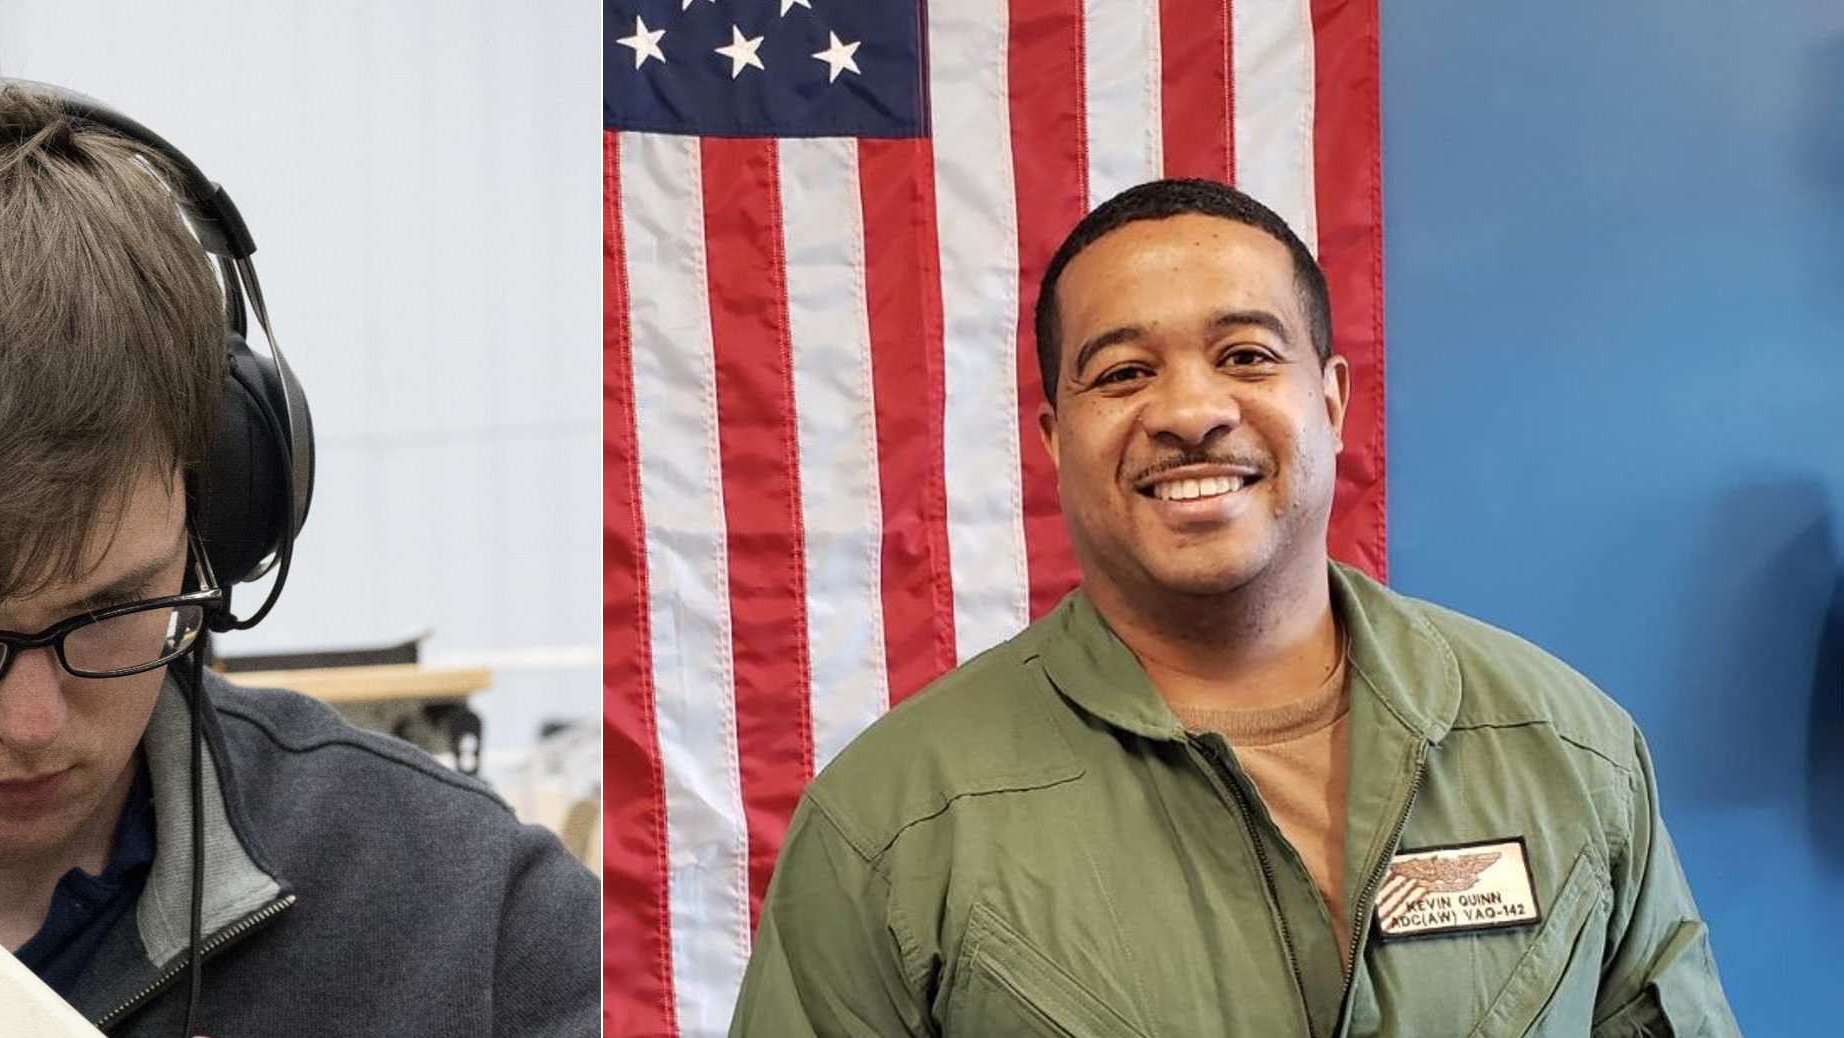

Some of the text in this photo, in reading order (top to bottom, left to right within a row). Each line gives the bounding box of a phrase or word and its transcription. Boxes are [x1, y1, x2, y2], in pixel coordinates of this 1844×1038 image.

[1406, 892, 1502, 913] KEVIN QUINN
[1391, 909, 1456, 928] ADC(AW)
